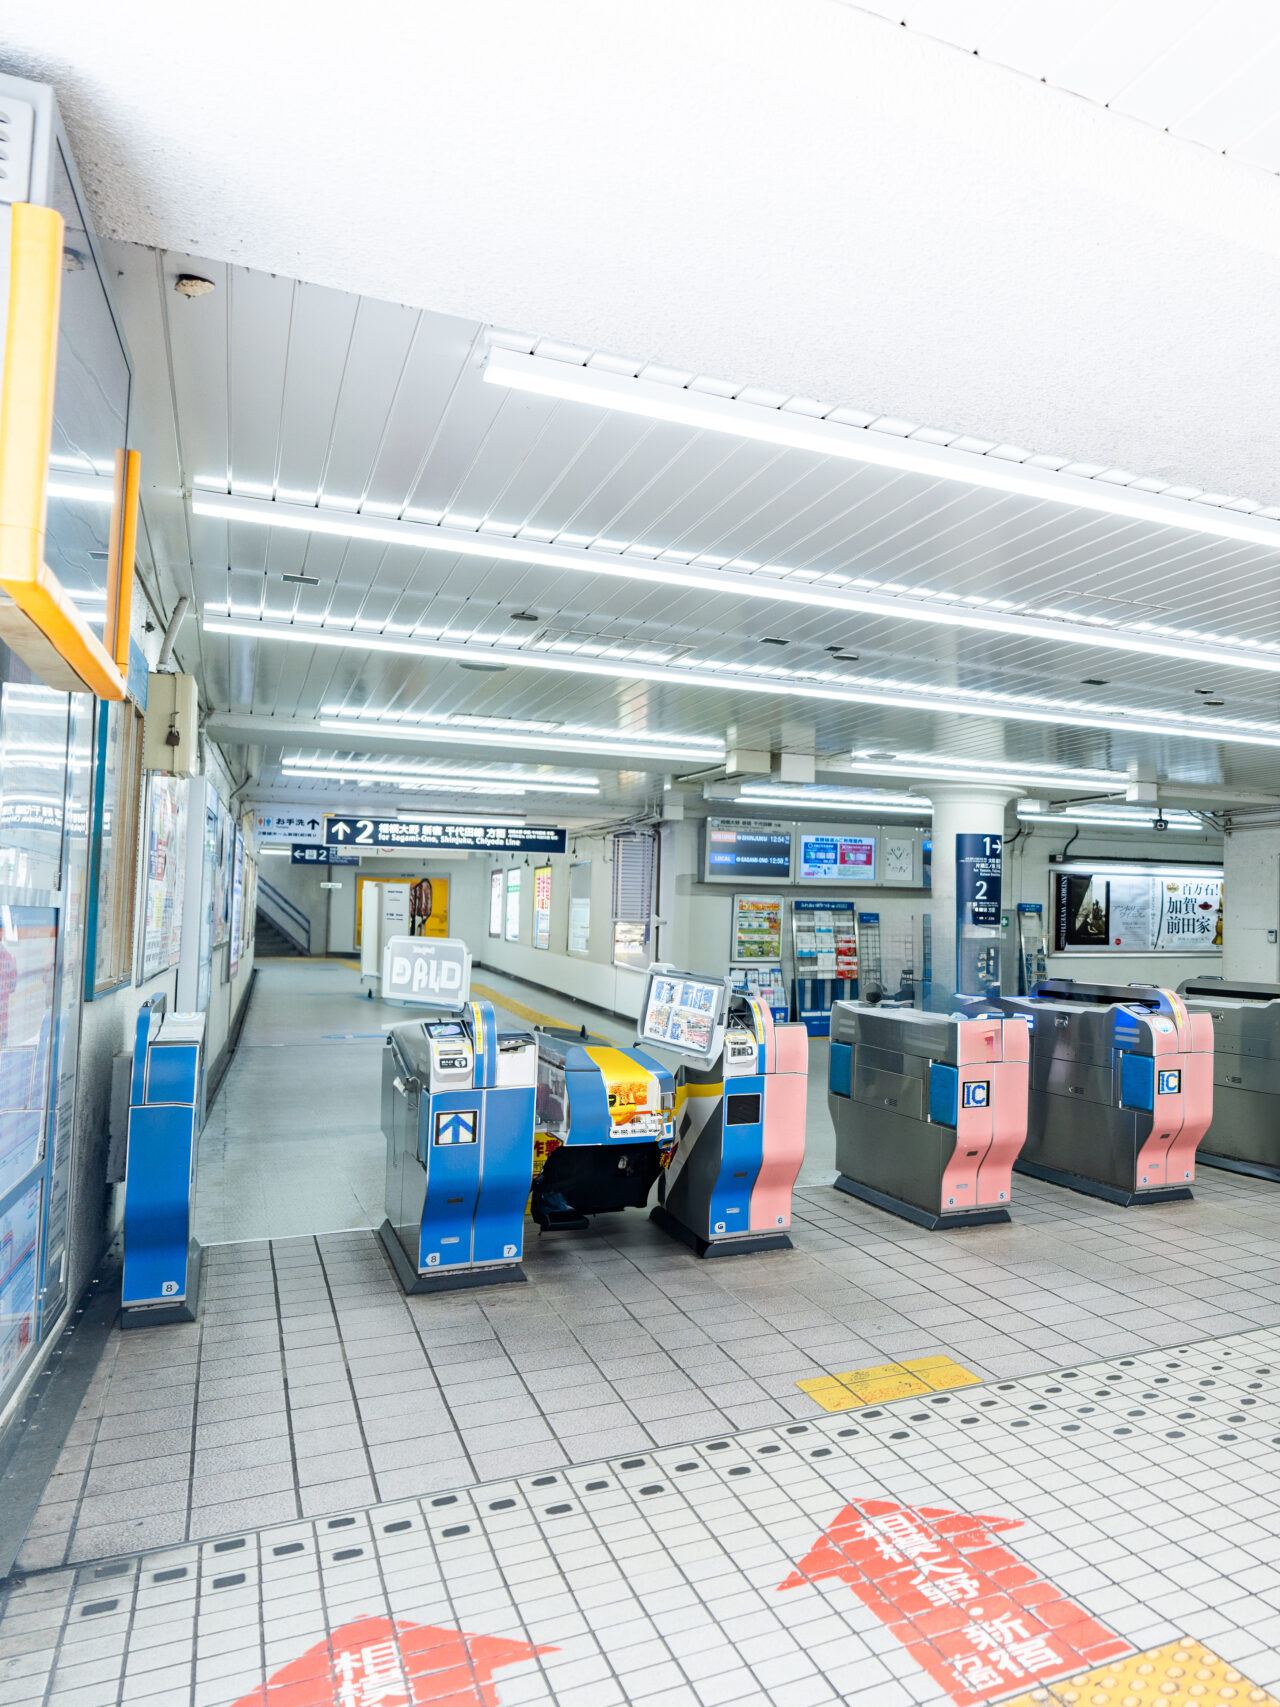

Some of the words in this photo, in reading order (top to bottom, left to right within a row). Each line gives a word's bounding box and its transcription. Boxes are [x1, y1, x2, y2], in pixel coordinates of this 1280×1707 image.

[355, 820, 374, 844] 2
[378, 833, 390, 841] for
[476, 837, 504, 847] Chiyoda
[505, 839, 521, 847] Line
[319, 850, 327, 860] 2
[983, 837, 991, 855] 1
[975, 881, 987, 899] 2
[1167, 896, 1197, 915] 加賀
[1166, 916, 1211, 935] 前田家
[1160, 1073, 1178, 1092] IC
[965, 1085, 985, 1105] IC
[166, 1284, 173, 1292] 8
